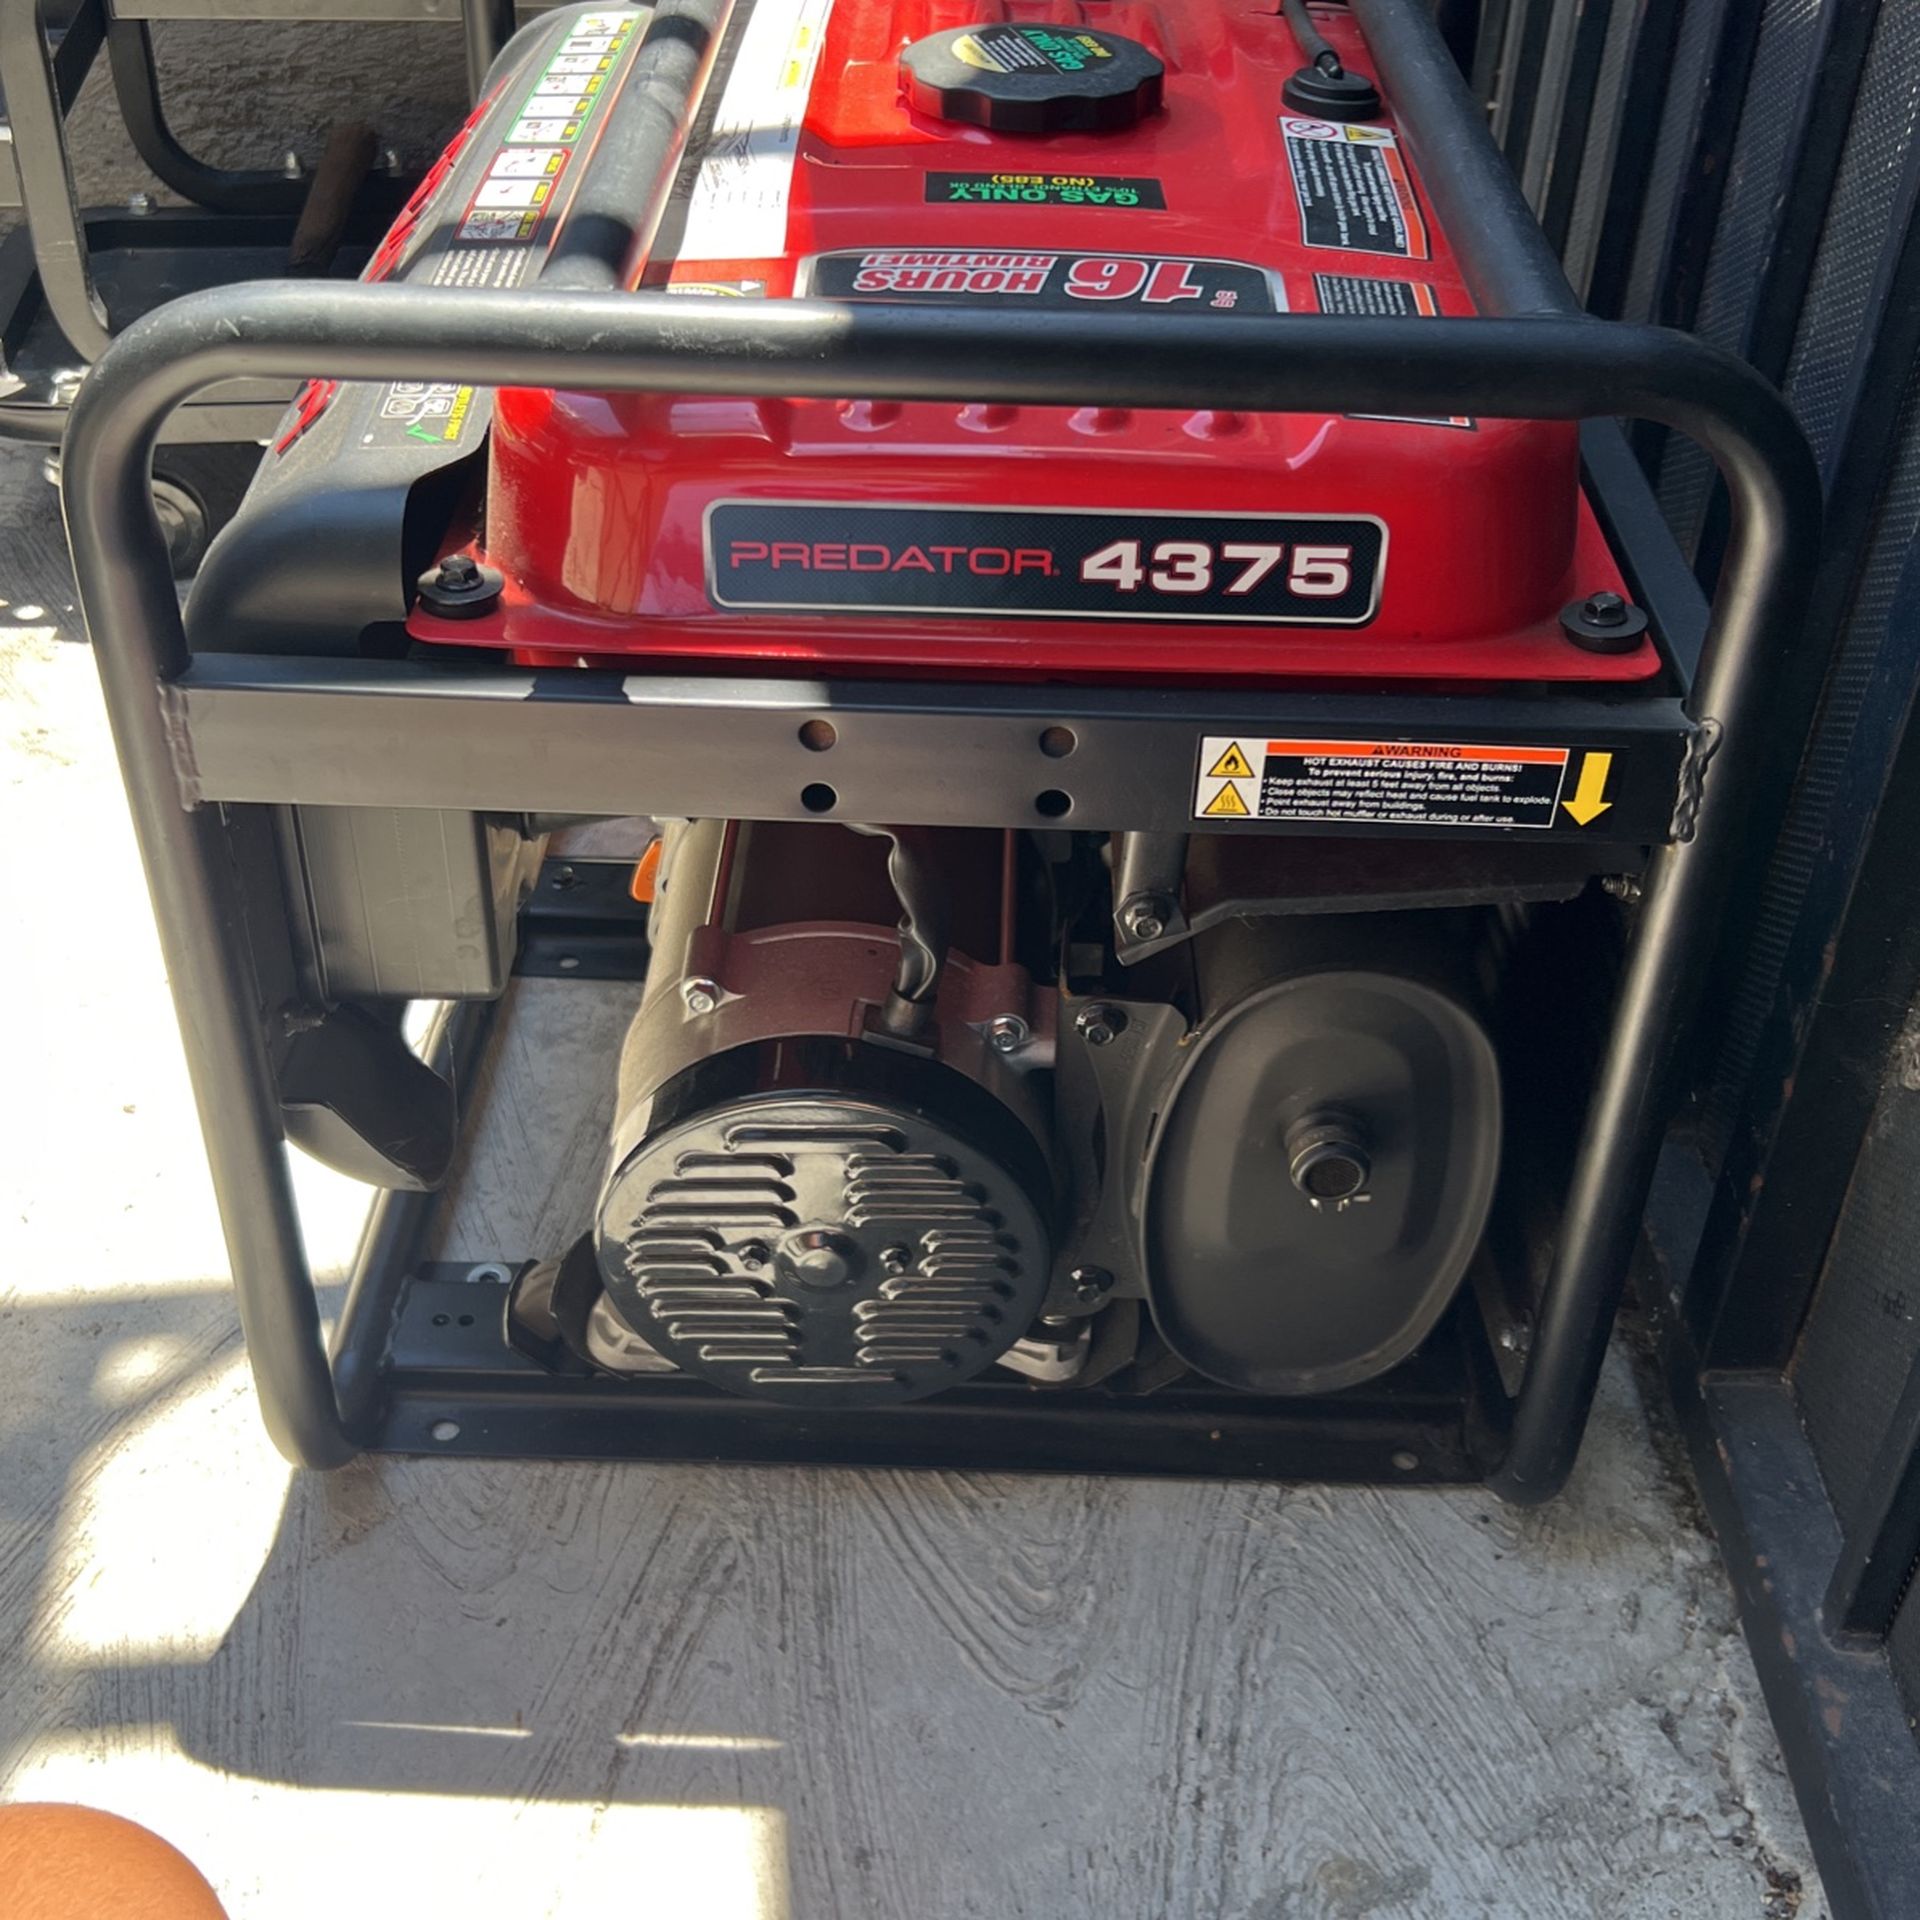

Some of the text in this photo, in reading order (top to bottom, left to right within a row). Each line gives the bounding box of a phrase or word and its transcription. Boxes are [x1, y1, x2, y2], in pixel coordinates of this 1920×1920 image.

[1048, 51, 1085, 70] GAS
[973, 182, 1026, 190] BLEND
[992, 174, 1095, 186] (NO E85)
[1031, 184, 1101, 192] ETHANOL
[949, 188, 1139, 205] GAS ONLY
[860, 254, 1058, 268] RUNTIME!
[852, 267, 1048, 293] HOURS
[1064, 257, 1203, 302] 16
[1214, 291, 1237, 300] TO
[1210, 299, 1236, 307] UP
[731, 539, 1352, 598] PREDATOR 4375
[1385, 746, 1462, 758] WARNING
[1303, 757, 1523, 772] HOT EXHAUST CAUSES FIRE AND BURNS!
[1323, 769, 1362, 778] prevent
[1364, 770, 1401, 778] serious
[1460, 773, 1479, 781] and
[1268, 777, 1294, 787] Keep
[1296, 778, 1333, 787] exhaust
[1347, 780, 1370, 788] least
[1381, 780, 1399, 788] feet
[1401, 782, 1426, 791] away
[1428, 782, 1450, 790] from
[1268, 788, 1295, 796] Close
[1297, 788, 1330, 798] objects
[1332, 790, 1353, 799] may
[1355, 789, 1384, 798] reflect
[1386, 790, 1407, 798] heat
[1410, 792, 1427, 800] and
[1429, 794, 1458, 802] cause
[1460, 794, 1477, 802] fuel
[1480, 795, 1501, 803] tank
[1266, 798, 1291, 806] Point
[1293, 799, 1330, 807] exhaust
[1331, 800, 1356, 809] away
[1359, 799, 1380, 808] from
[1264, 807, 1280, 815] Do
[1281, 808, 1297, 816] not
[1298, 808, 1324, 817] touch
[1326, 809, 1341, 817] hot
[1343, 809, 1376, 818] muffler
[1389, 810, 1427, 819] exhaust
[1428, 813, 1458, 822] during
